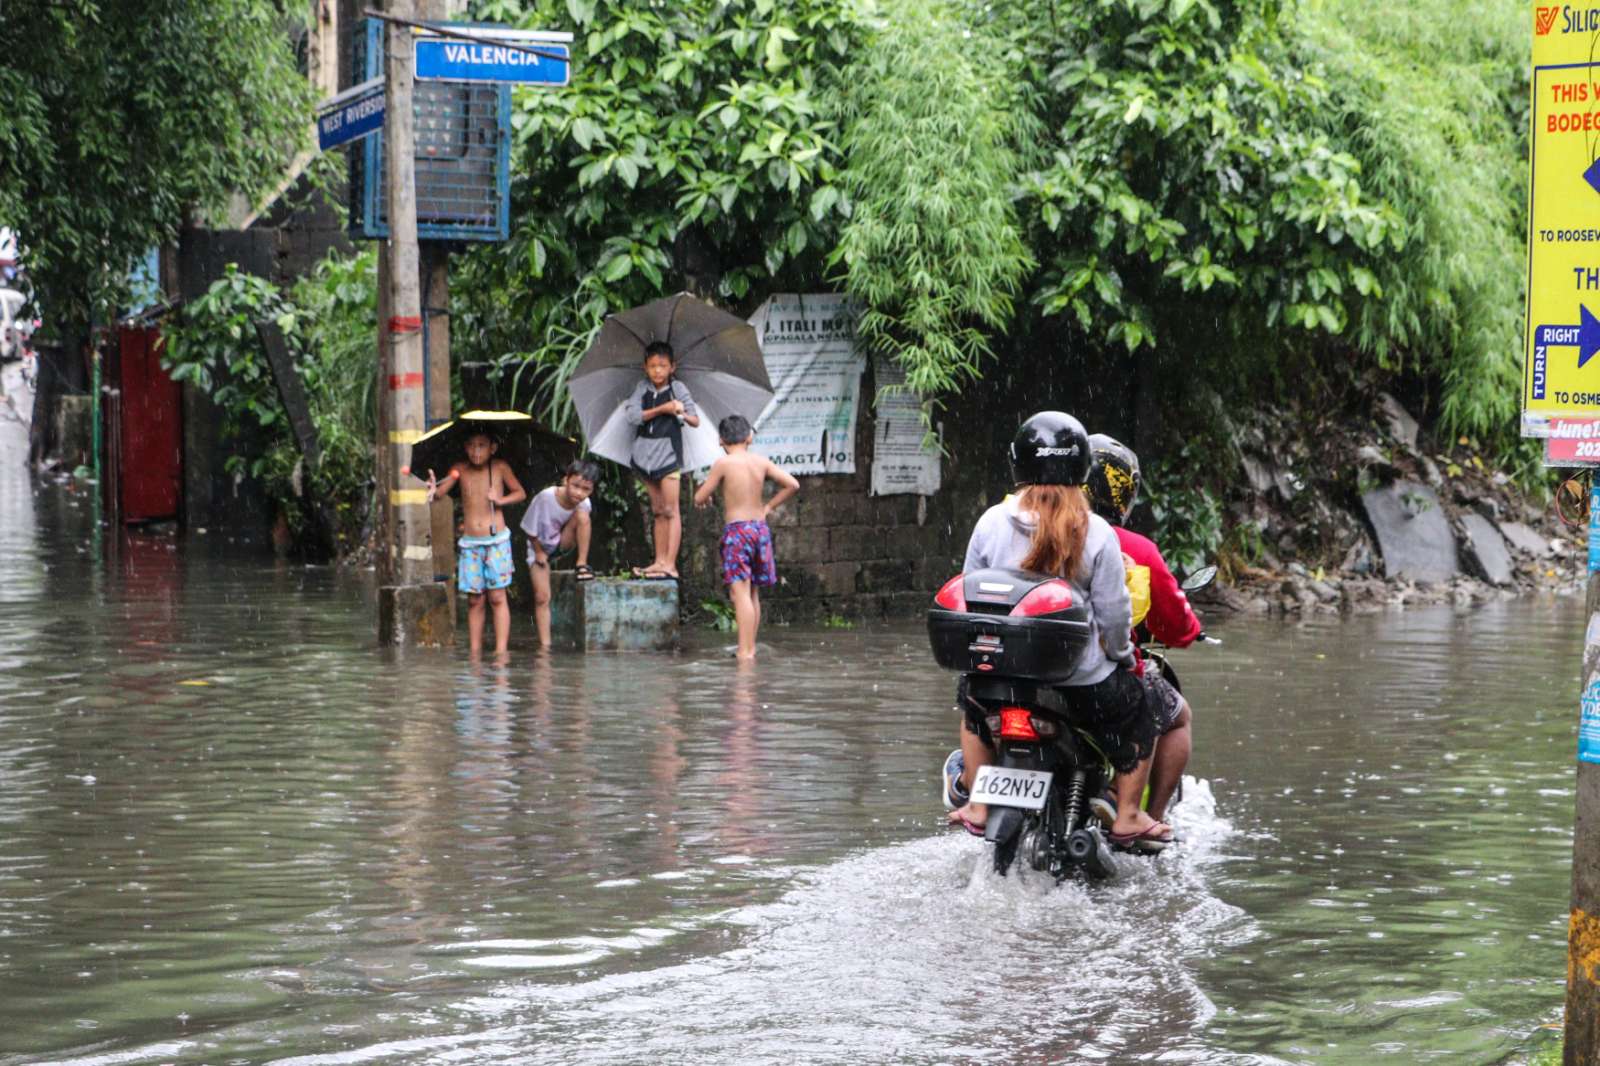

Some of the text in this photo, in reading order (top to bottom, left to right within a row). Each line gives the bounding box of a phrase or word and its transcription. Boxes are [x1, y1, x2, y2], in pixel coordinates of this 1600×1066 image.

[445, 45, 539, 66] VALENCIA
[1552, 83, 1588, 103] THIS
[322, 111, 343, 135] WEST
[1540, 230, 1554, 242] TO
[1543, 328, 1580, 343] RIGHT
[1534, 346, 1546, 397] TURN
[1555, 391, 1569, 404] TO
[975, 774, 1046, 799] 162NYJ
